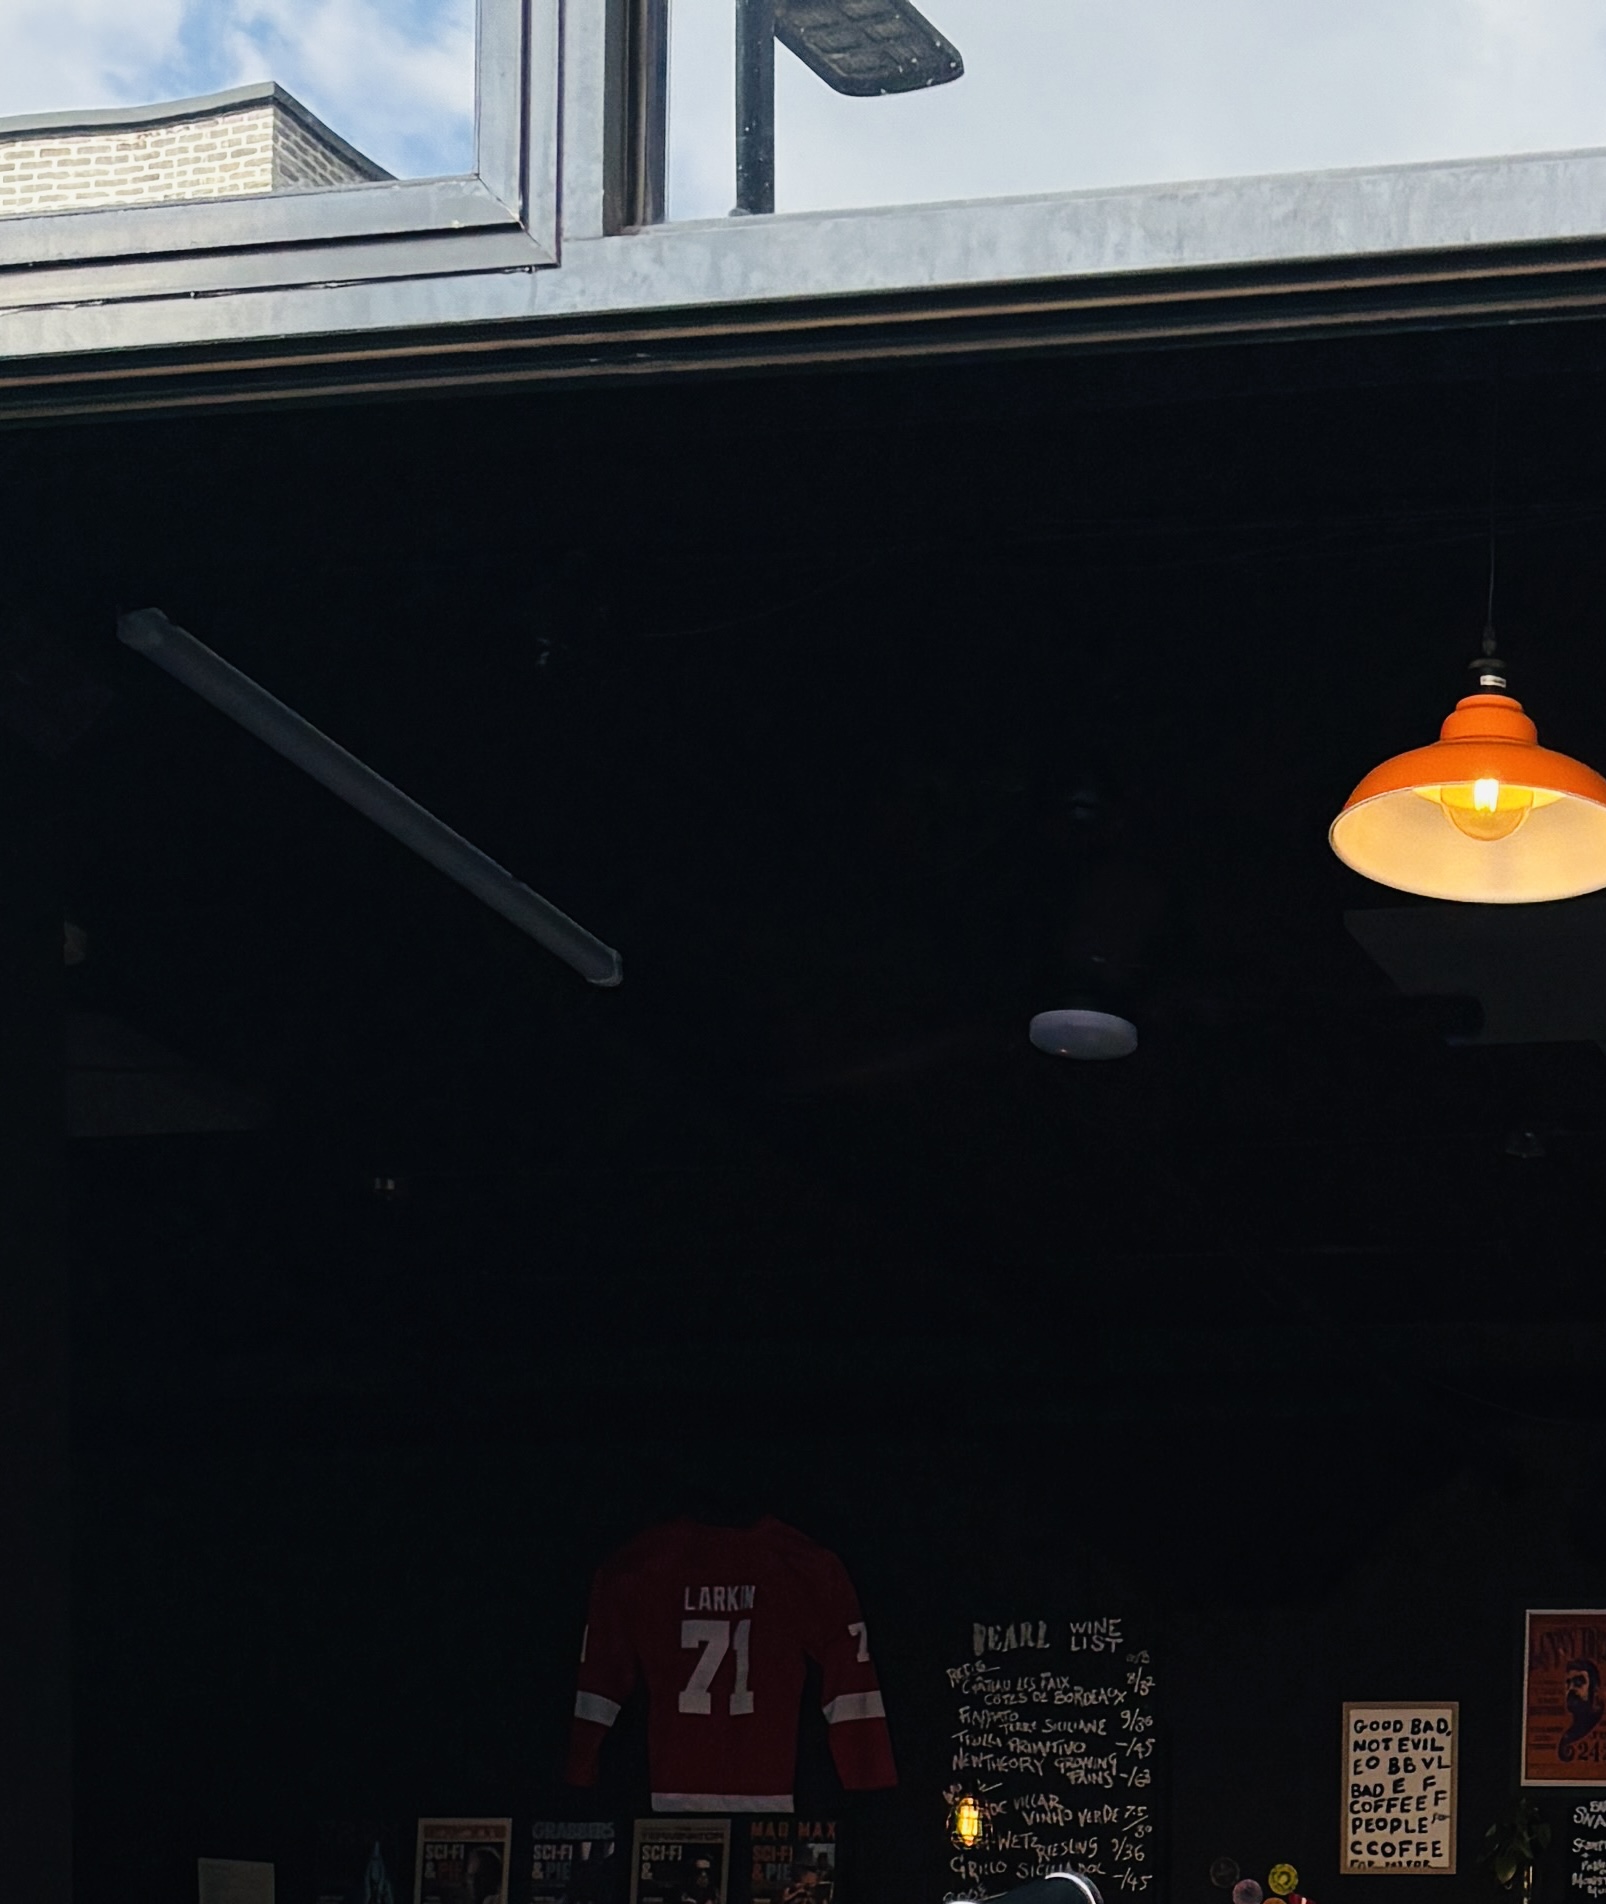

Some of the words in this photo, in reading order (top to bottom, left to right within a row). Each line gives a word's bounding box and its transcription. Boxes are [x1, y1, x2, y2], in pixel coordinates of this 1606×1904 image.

[684, 1584, 757, 1613] LARKIN
[972, 1619, 1051, 1657] PEARL
[1069, 1617, 1123, 1639] WINE
[1069, 1636, 1124, 1654] LIST
[679, 1618, 752, 1717] 71
[1353, 1719, 1404, 1735] GOOD
[1410, 1718, 1452, 1737] BAD,
[1352, 1737, 1393, 1753] NOT
[1398, 1737, 1445, 1753] EVIL
[1351, 1782, 1385, 1799] BAD
[1392, 1777, 1406, 1795] E
[1422, 1775, 1437, 1792] F
[1349, 1795, 1428, 1815] COFFEE
[749, 1821, 791, 1840] MAD
[797, 1821, 838, 1841] MAX
[1352, 1816, 1429, 1836] PEOPLE
[425, 1844, 466, 1862] SCI-FI
[533, 1844, 574, 1861] SCI-FI
[641, 1844, 683, 1862] SCI-FI
[752, 1845, 794, 1862] SCI-FI
[532, 1863, 546, 1881] &
[641, 1863, 654, 1881] &
[751, 1863, 765, 1882] &
